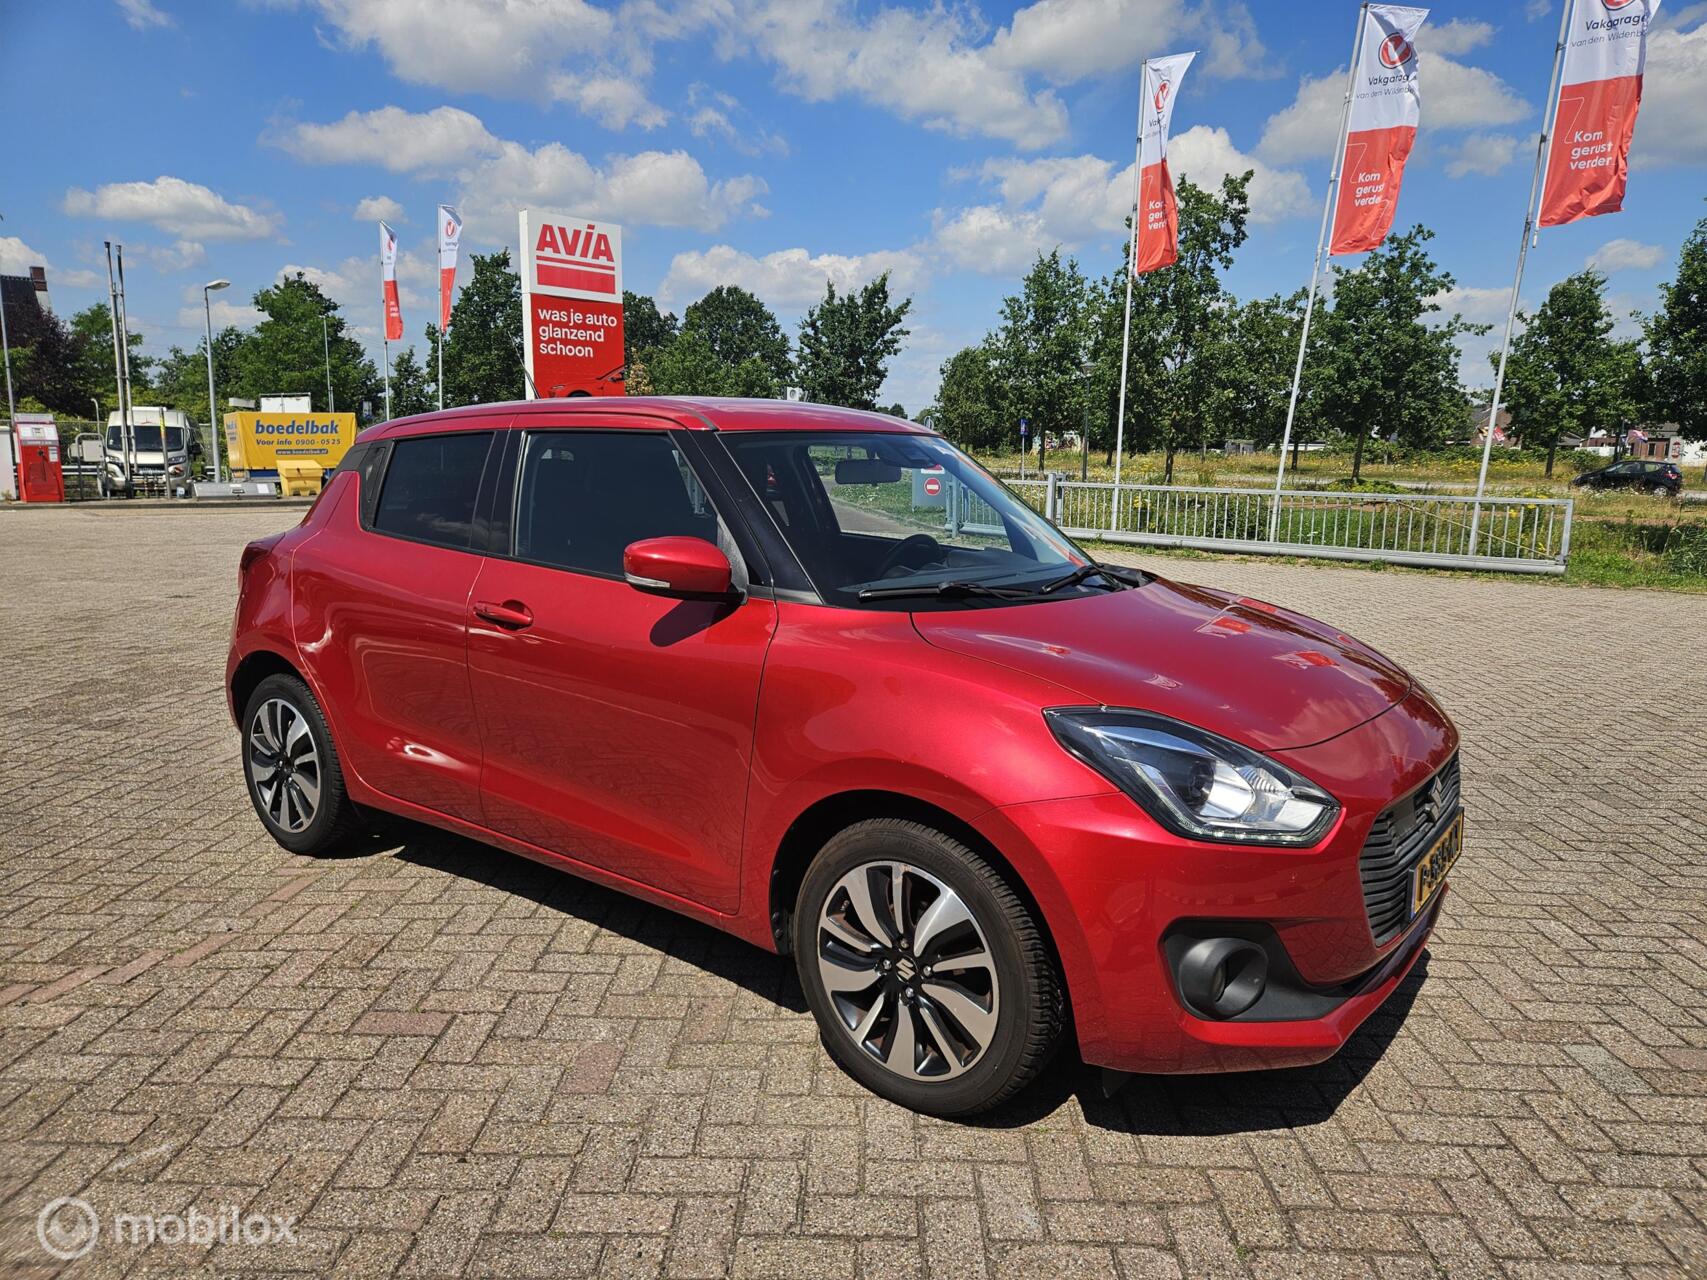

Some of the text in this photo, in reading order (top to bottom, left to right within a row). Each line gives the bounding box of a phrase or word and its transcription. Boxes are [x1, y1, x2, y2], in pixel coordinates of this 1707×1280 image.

[1588, 36, 1604, 45] den
[1368, 74, 1410, 85] Vakgarag
[1574, 130, 1603, 143] Kom
[1571, 141, 1613, 160] gerust
[1569, 156, 1613, 170] verder
[1358, 172, 1380, 183] Kom
[538, 308, 617, 327] was je auto
[539, 323, 605, 342] glanzend
[539, 341, 594, 358] schoon
[255, 419, 338, 434] boedelbak
[276, 438, 292, 446] info
